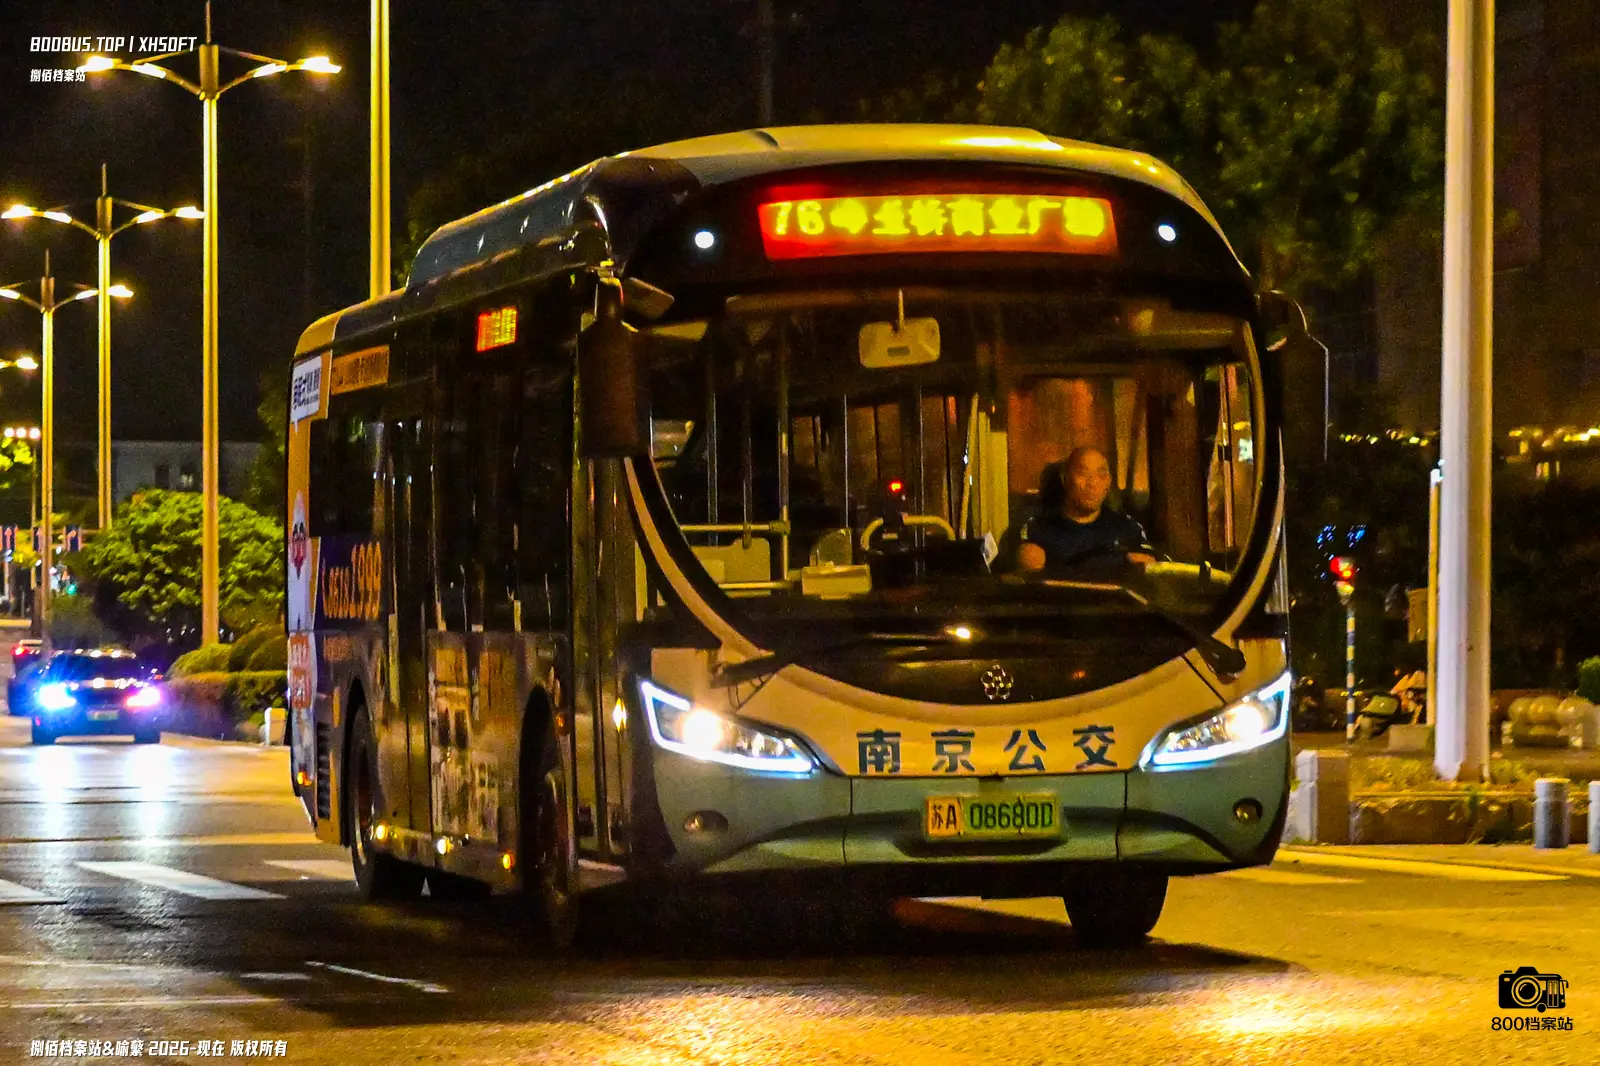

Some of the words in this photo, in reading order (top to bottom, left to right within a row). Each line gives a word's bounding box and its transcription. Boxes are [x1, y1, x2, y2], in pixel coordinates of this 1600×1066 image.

[856, 724, 1118, 774] 南京公交
[969, 801, 1054, 830] 08680D
